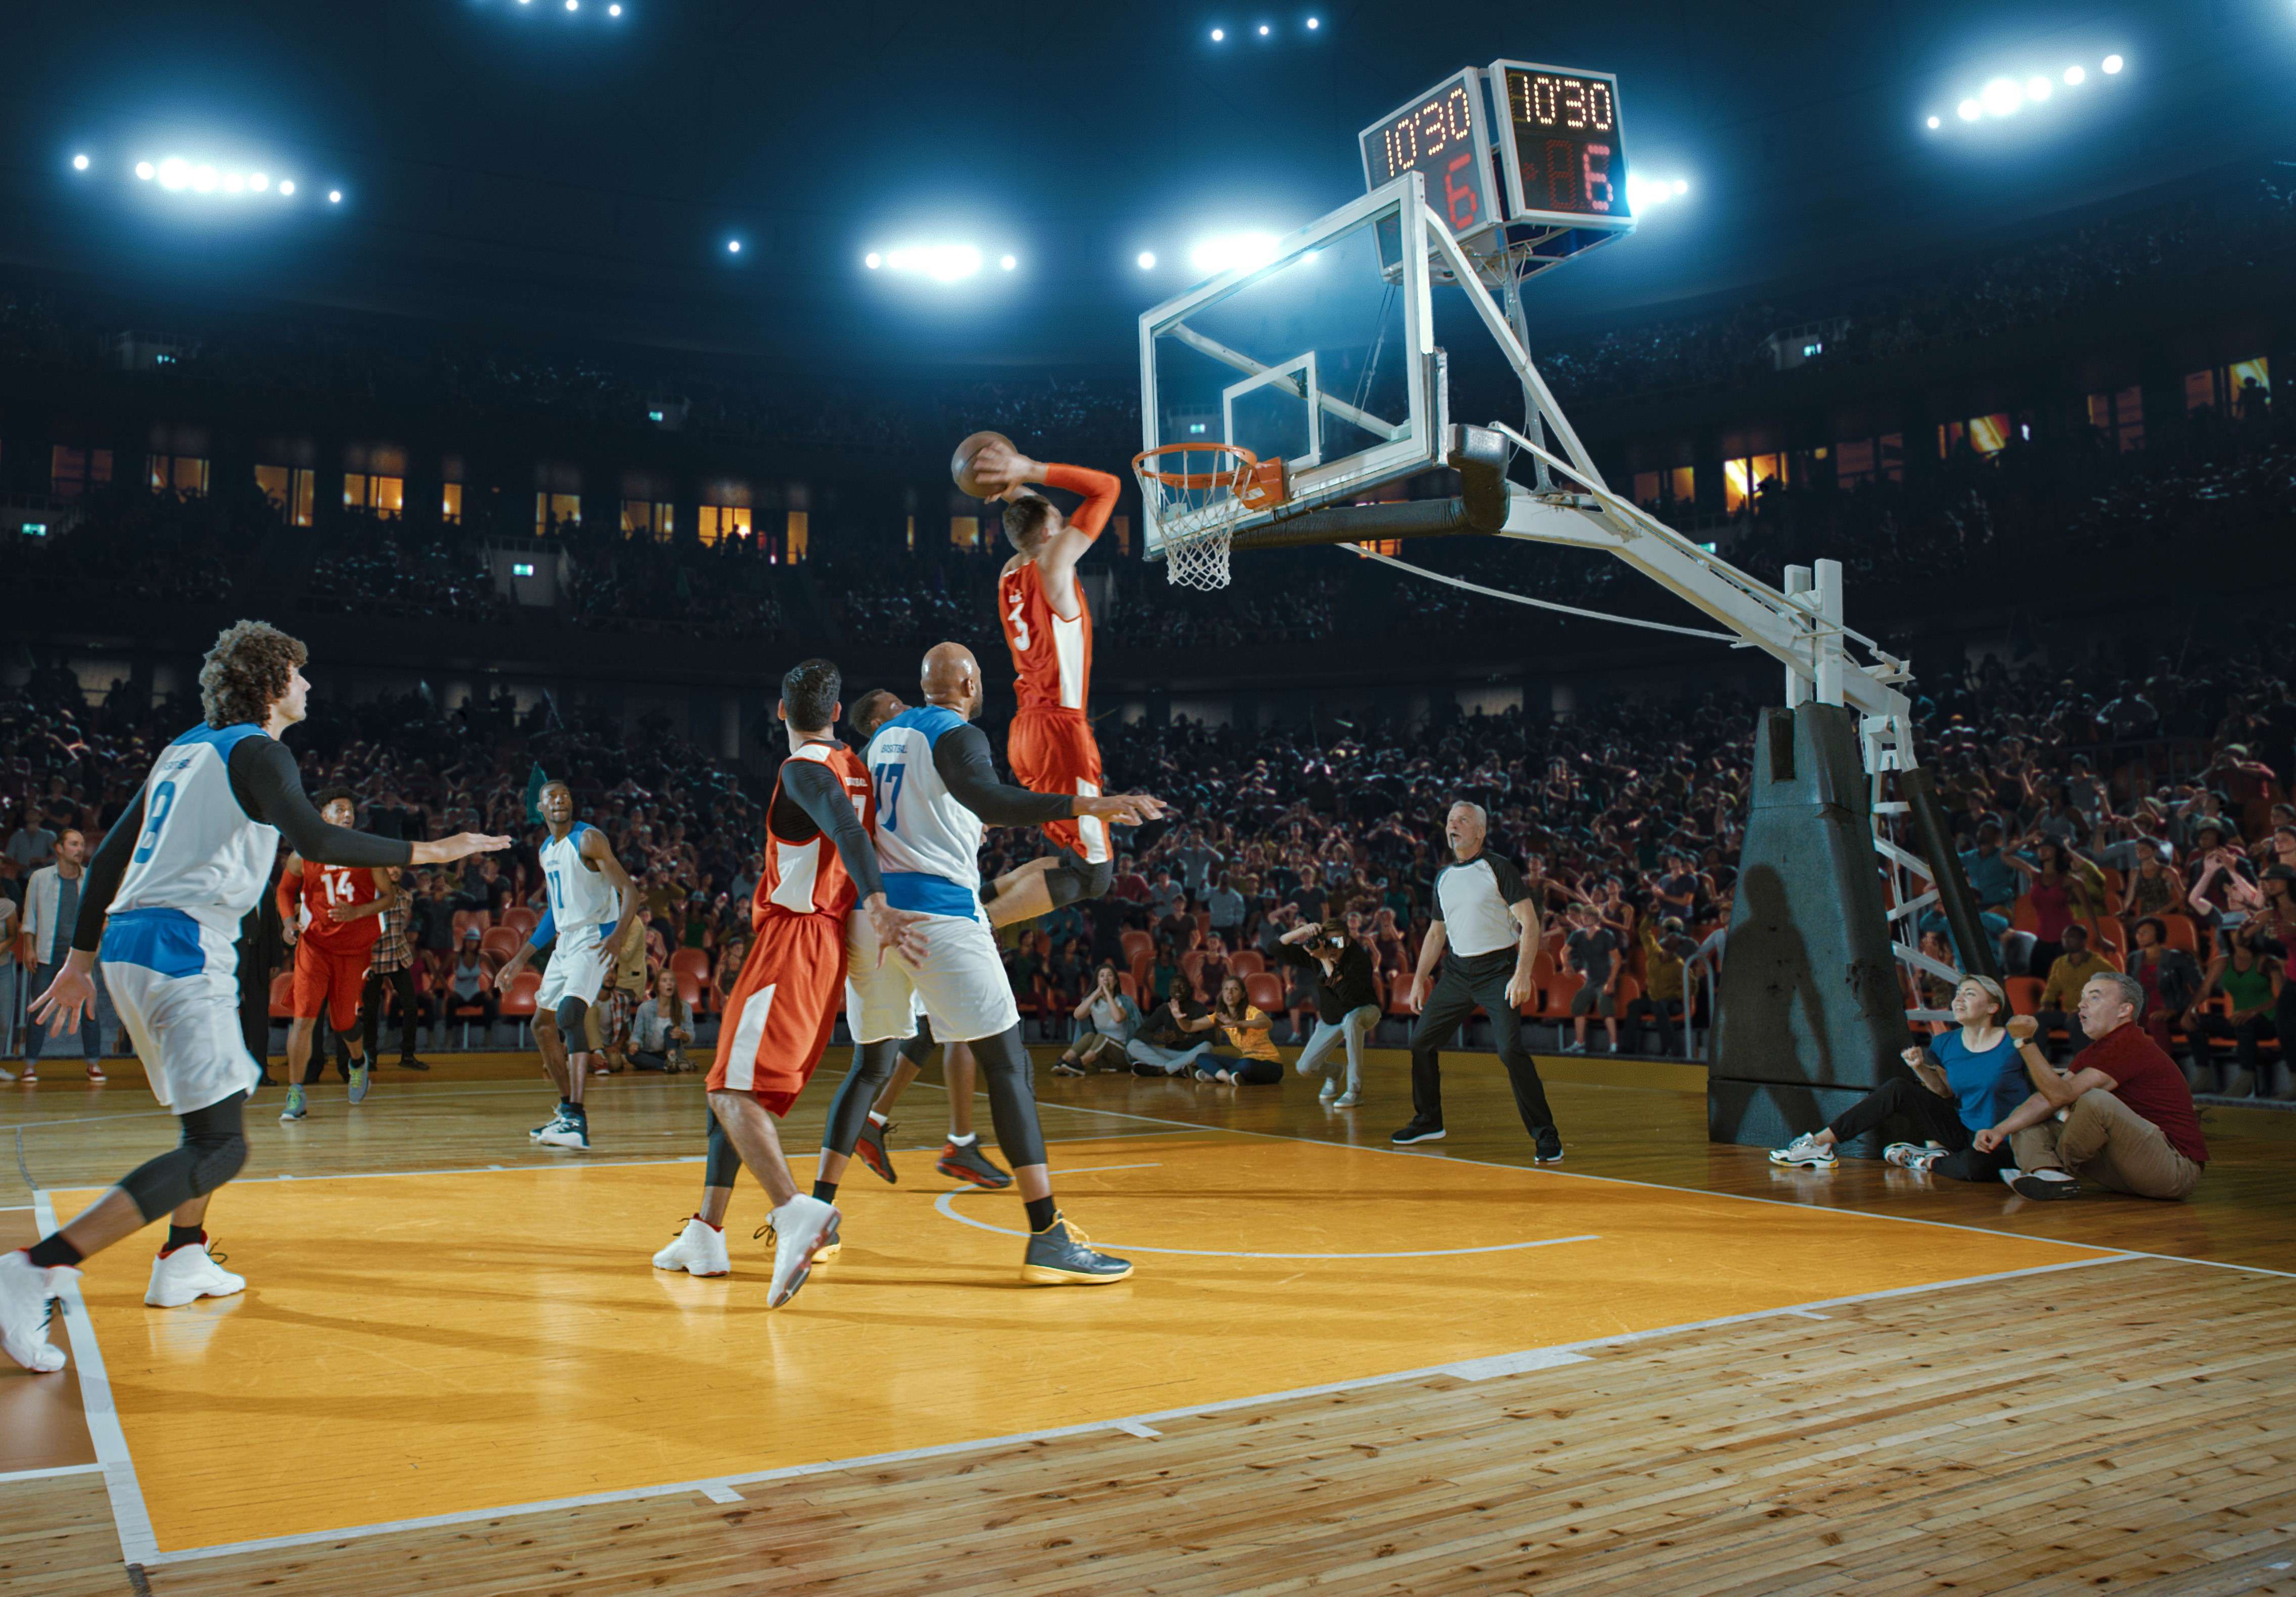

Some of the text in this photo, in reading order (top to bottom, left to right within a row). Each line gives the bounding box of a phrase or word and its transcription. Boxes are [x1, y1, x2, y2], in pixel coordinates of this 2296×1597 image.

[1444, 153, 1477, 230] 6
[1582, 144, 1614, 211] 6
[1007, 602, 1030, 651] 3
[875, 763, 906, 832] 17
[320, 870, 355, 907] 14
